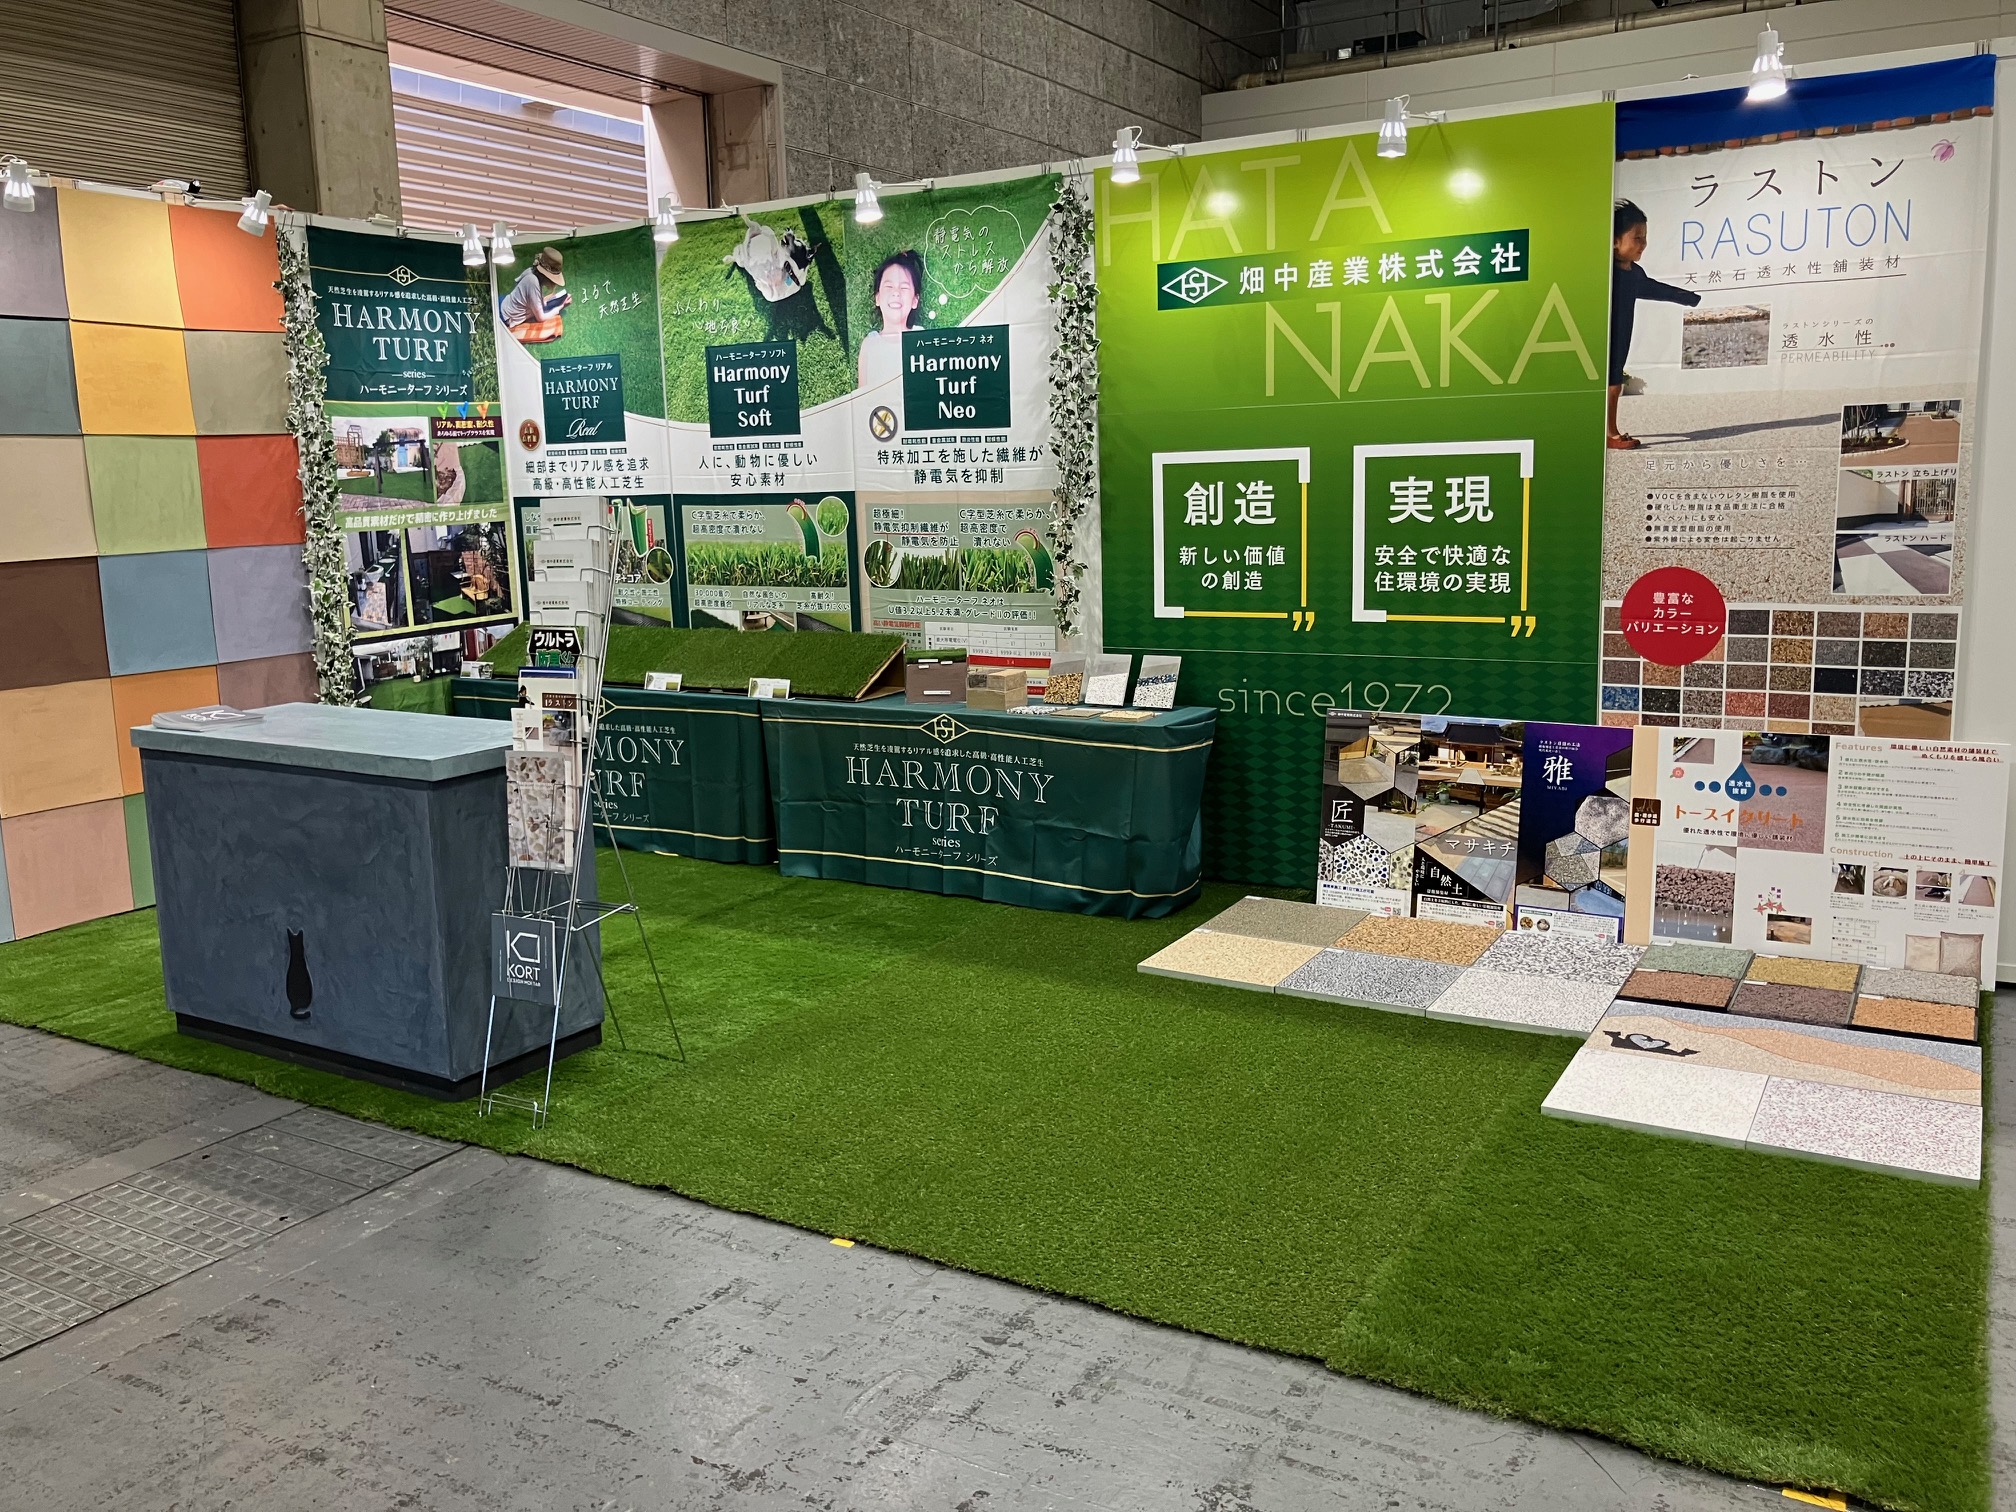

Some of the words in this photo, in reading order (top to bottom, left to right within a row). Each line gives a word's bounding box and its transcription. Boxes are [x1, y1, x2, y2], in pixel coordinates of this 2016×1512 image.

[1690, 156, 1905, 208] ラストン
[1101, 138, 1393, 267] HATA
[932, 226, 989, 245] 静電気の
[1681, 198, 1912, 262] RASUTON
[941, 241, 996, 260] ストレス
[954, 258, 1011, 276] から解放
[1238, 242, 1522, 296] 畑中産業株式会社
[1684, 254, 1901, 285] 天然石透水性舗装材
[598, 291, 643, 319] 天然芝生
[673, 299, 720, 315] ふんわり
[331, 302, 481, 334] HARMONY
[1782, 317, 1874, 330] ラストンシリーズの
[916, 336, 976, 348] ハーモニーターフ
[979, 334, 995, 344] ネオ
[1265, 281, 1600, 400] NAKA
[1781, 328, 1873, 350] 透水性
[372, 337, 449, 362] TURF
[715, 350, 767, 362] ハーモニーターフ
[769, 348, 787, 358] ソフト
[1780, 348, 1876, 364] PERMEABILITY
[548, 363, 593, 374] ハーモニーターフ
[595, 362, 613, 372] リアル
[910, 353, 1002, 374] Harmony
[402, 369, 427, 379] series
[713, 364, 791, 384] Harmony
[359, 384, 432, 395] ハーモニーターフ
[435, 384, 468, 396] シリーズ
[544, 378, 619, 395] HARMONY
[734, 384, 770, 405] Turf
[935, 375, 978, 396] Turf
[561, 395, 600, 411] TURF
[938, 400, 976, 420] Neo
[737, 408, 772, 428] Soft
[565, 417, 604, 439] Real
[698, 453, 818, 470] 人に、動物に優しい
[877, 444, 1044, 466] 特殊加工を施した繊維が
[525, 457, 650, 474] 細部までリアル感を追求
[1876, 470, 1910, 479] ラストン
[532, 476, 645, 491] 高級・高性能人工芝生
[730, 472, 787, 488] 安心素材
[914, 467, 1004, 485] 静電気を抑制
[1183, 480, 1278, 527] 創造
[1387, 474, 1495, 525] 実現
[959, 508, 1050, 520] C字型芝糸で柔らか、
[960, 522, 1008, 534] 超高密度で
[901, 535, 960, 547] 静電気を防止
[973, 536, 1011, 547] 潰れない
[1884, 533, 1918, 543] ラストン
[1920, 533, 1948, 542] ハード
[1178, 545, 1286, 567] 新しい価値
[1373, 544, 1512, 567] 安全で快適な
[1200, 570, 1264, 592] の創造
[1373, 570, 1512, 595] 住環境の実現
[1652, 591, 1695, 605] 豊富な
[1653, 607, 1693, 619] カラー
[1626, 621, 1720, 635] バリエーション
[534, 631, 575, 648] ウルトラ
[1835, 742, 1883, 752] Features
[845, 755, 1055, 805] HARMONY
[1542, 755, 1574, 786] 雅
[896, 797, 1000, 836] TURF
[1331, 799, 1354, 824] 匠
[1676, 804, 1804, 830] トースイクリート
[931, 836, 961, 848] series
[1444, 838, 1516, 858] マサキチ
[894, 845, 962, 863] ハーモニーターフ
[965, 852, 999, 867] シリーズ
[1830, 846, 1893, 859] Construction
[508, 963, 541, 981] KORT
